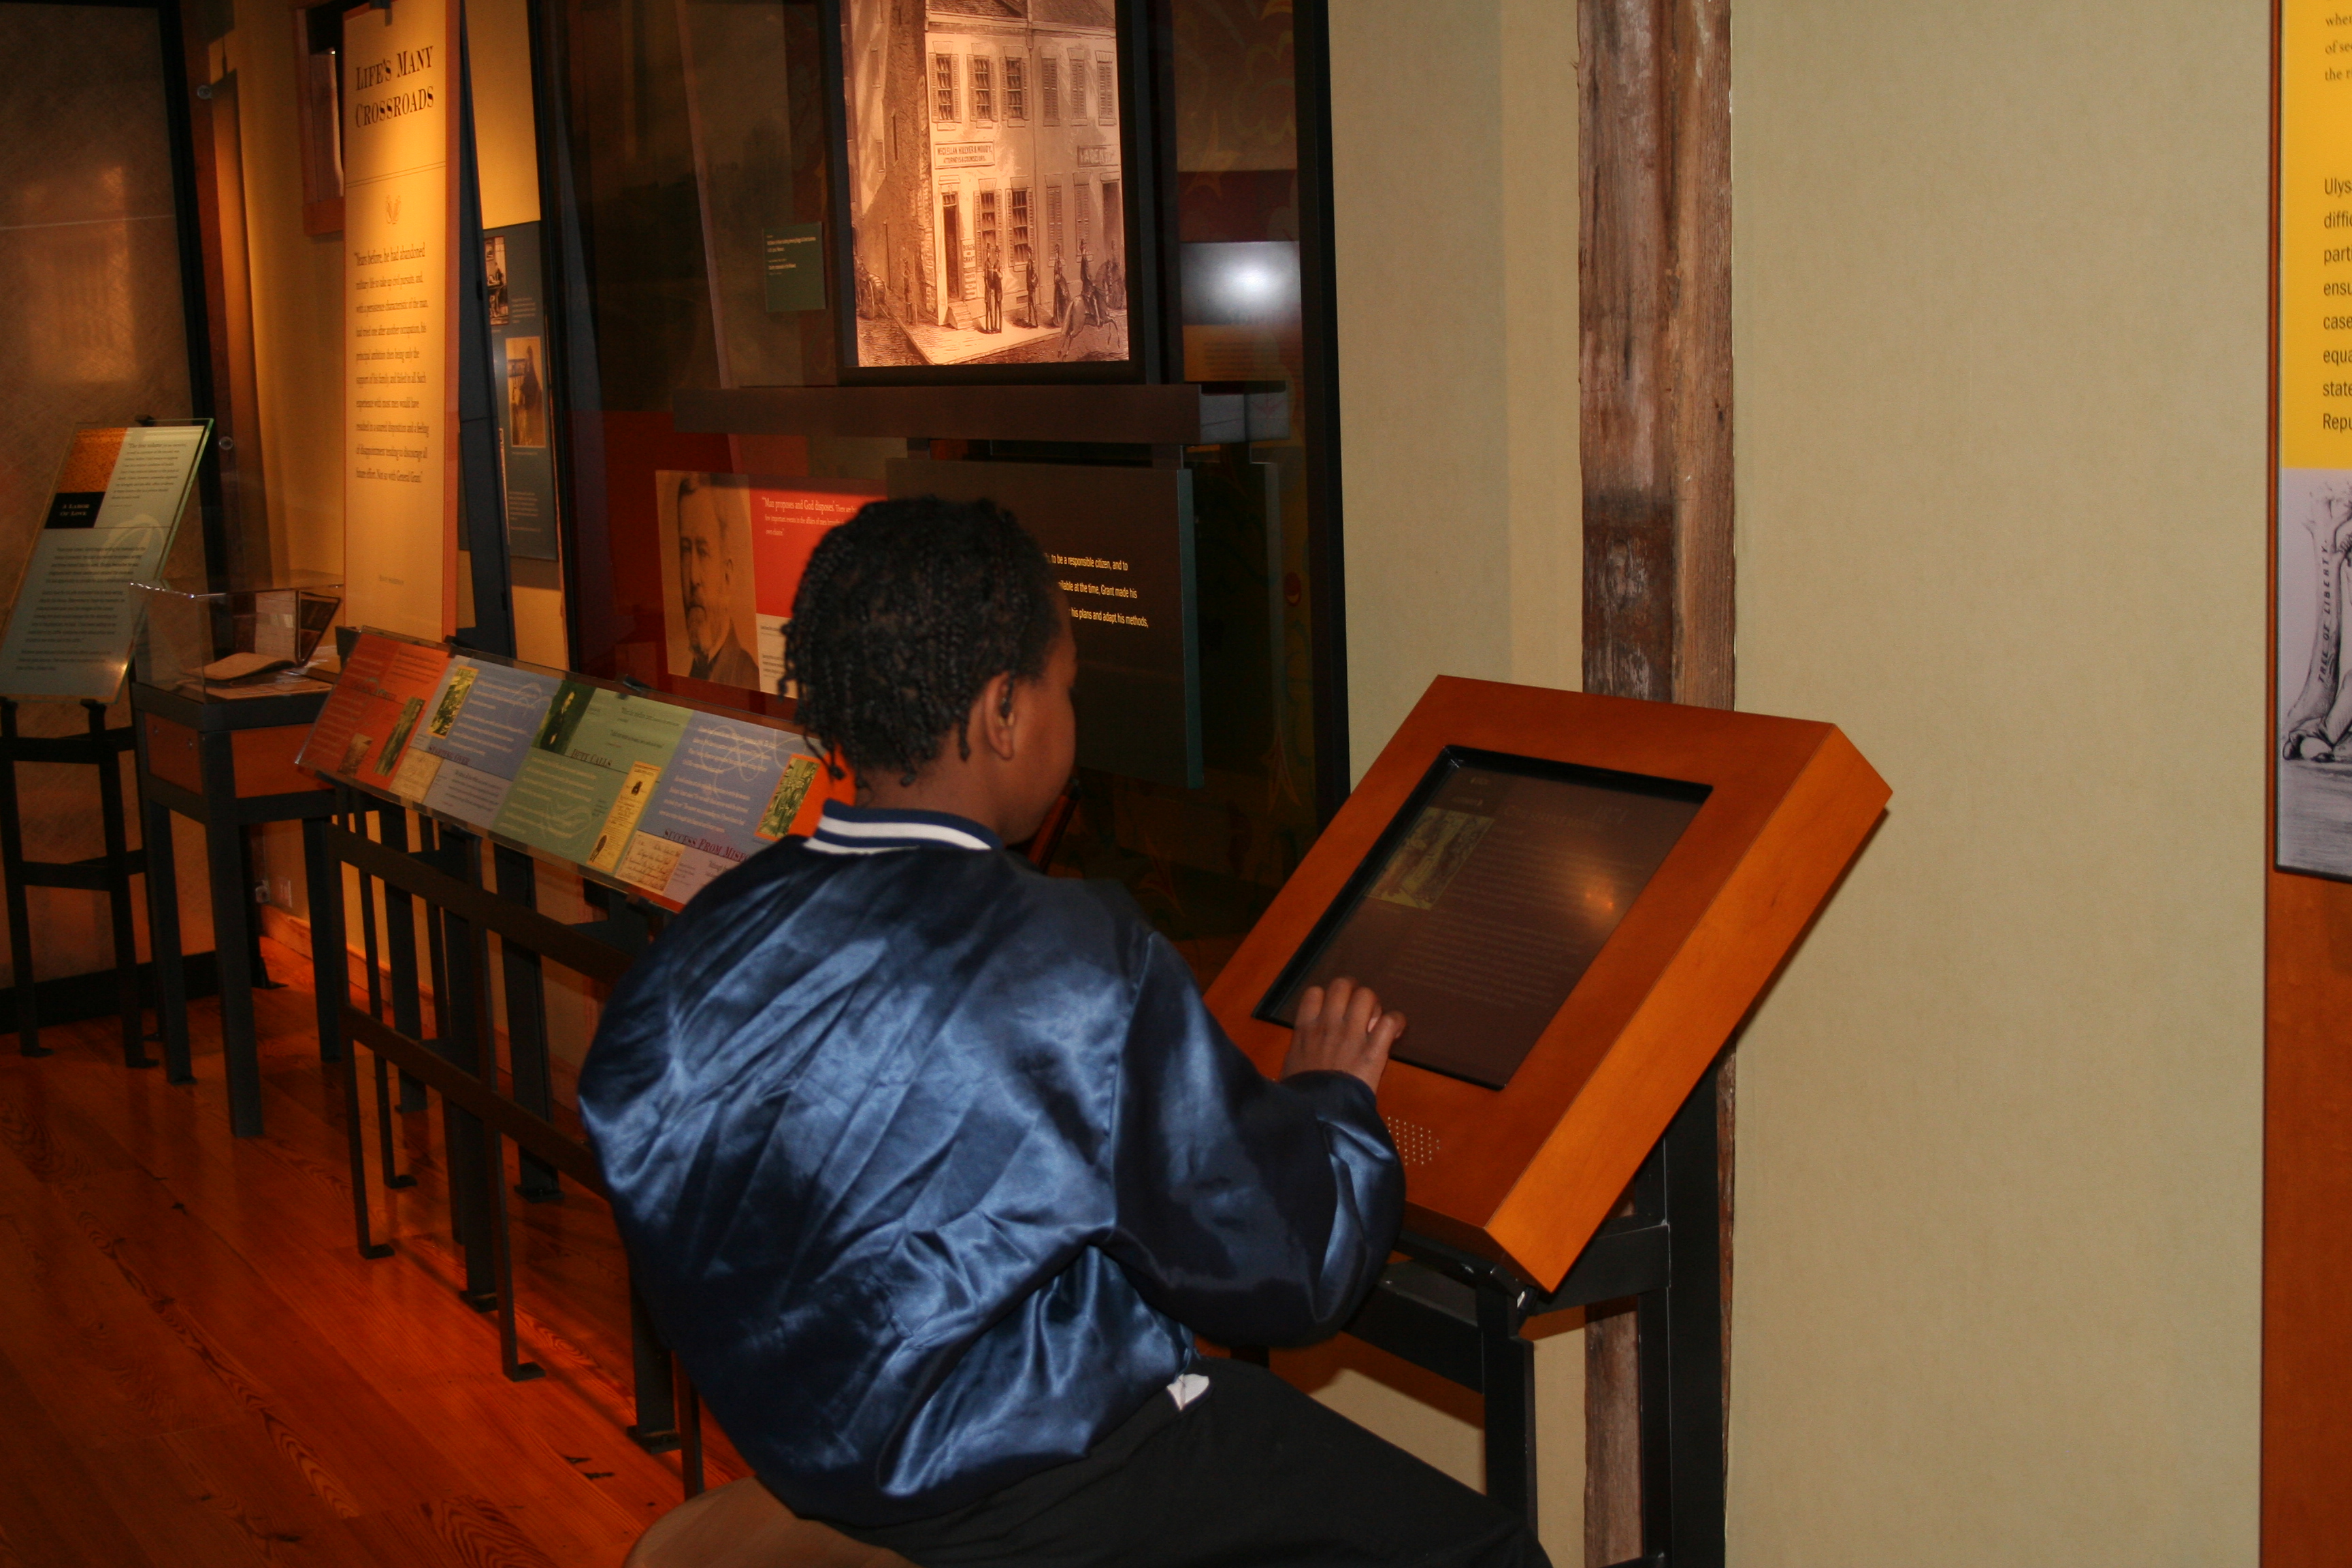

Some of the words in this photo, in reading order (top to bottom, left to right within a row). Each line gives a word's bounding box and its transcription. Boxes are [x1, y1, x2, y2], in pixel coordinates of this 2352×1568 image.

[2325, 40, 2338, 54] of
[357, 59, 391, 91] LIFE'S
[397, 46, 434, 78] MANY
[2325, 67, 2342, 81] the
[2346, 69, 2352, 78] r
[356, 86, 434, 128] CROSSROADS
[391, 246, 399, 261] had
[399, 242, 425, 260] abandoned
[775, 501, 795, 512] proposes
[795, 499, 803, 509] and
[804, 500, 814, 510] God
[1051, 555, 1056, 564] to
[1057, 554, 1063, 564] be
[1068, 554, 1094, 568] responsible
[1112, 560, 1122, 570] and
[1122, 561, 1128, 571] to
[1074, 583, 1079, 591] at
[1079, 583, 1088, 593] the
[1101, 584, 1115, 596] Grant
[1115, 588, 1129, 598] made
[1129, 588, 1137, 599] his
[1079, 608, 1092, 620] plans
[1093, 610, 1102, 621] and
[1102, 612, 1117, 624] adapt
[1117, 613, 1125, 624] his
[2317, 650, 2328, 684] TREE
[2323, 623, 2330, 641] OF
[664, 828, 698, 849] SUCCESS
[698, 838, 722, 855] FROM
